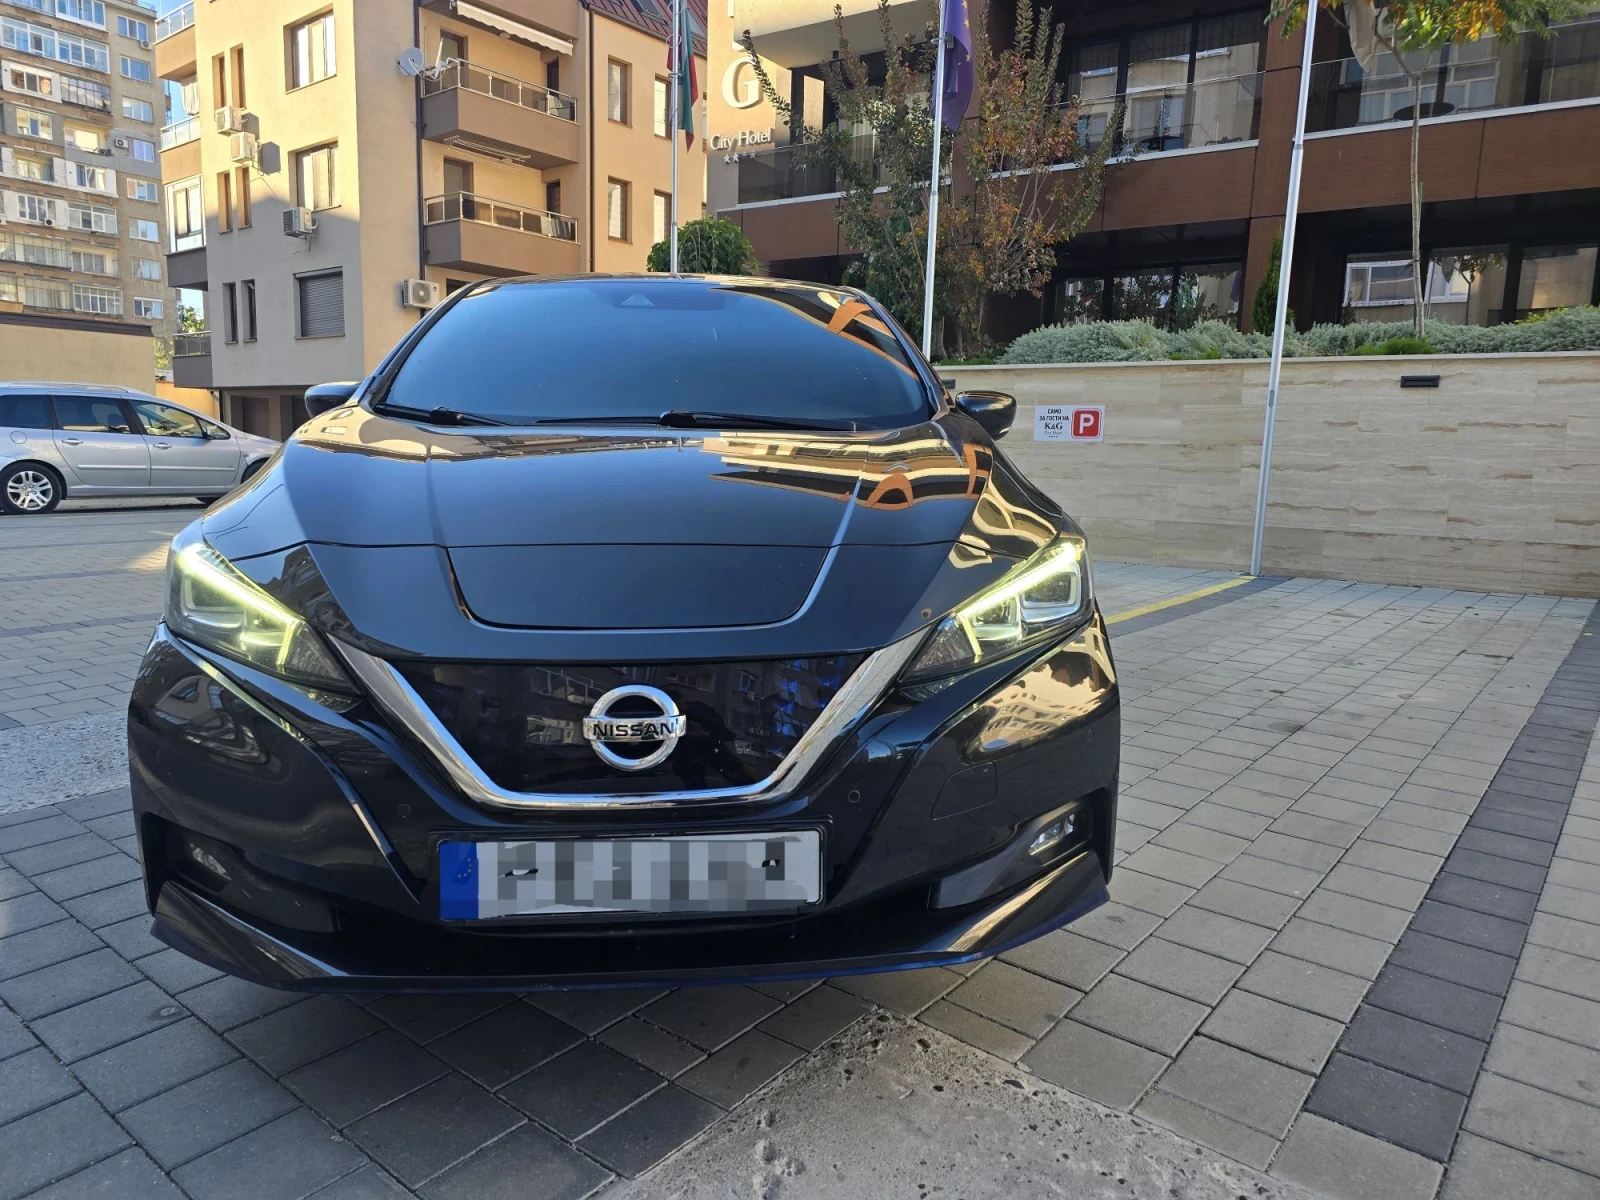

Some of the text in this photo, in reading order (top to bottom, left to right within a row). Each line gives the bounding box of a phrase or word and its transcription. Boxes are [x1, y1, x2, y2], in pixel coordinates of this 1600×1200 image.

[722, 56, 761, 108] G
[710, 128, 771, 151] City Hotel
[1044, 422, 1062, 430] K&G
[1079, 414, 1094, 434] P
[593, 722, 675, 737] NISSAN
